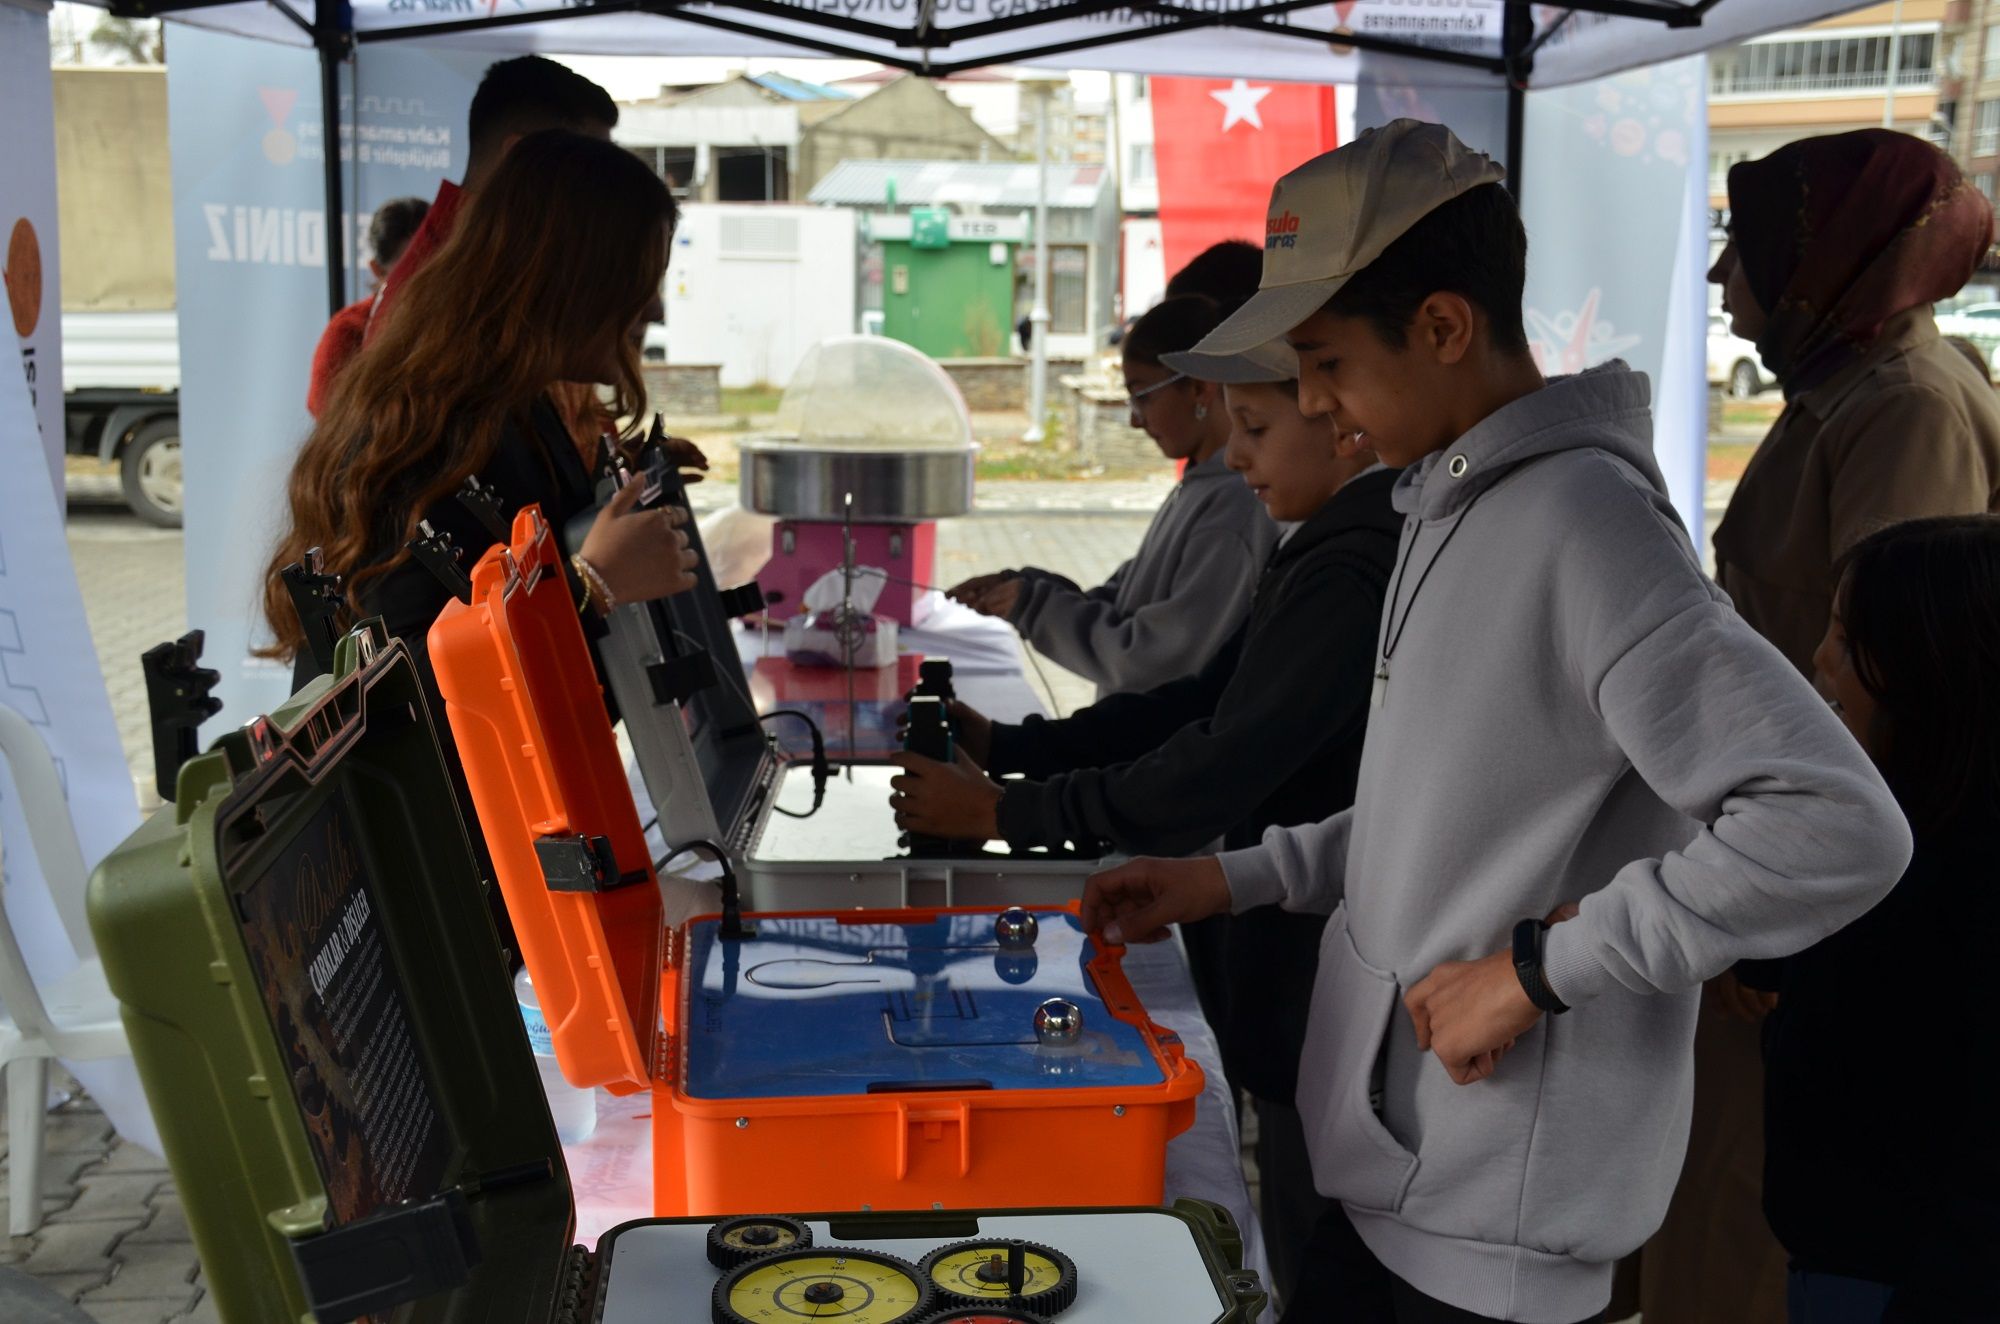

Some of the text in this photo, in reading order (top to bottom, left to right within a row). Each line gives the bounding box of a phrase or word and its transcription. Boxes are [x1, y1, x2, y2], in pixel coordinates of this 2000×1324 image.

[338, 923, 351, 954] &
[343, 887, 371, 944] DİŞLİLER
[309, 931, 346, 1005] ÇARKLAR
